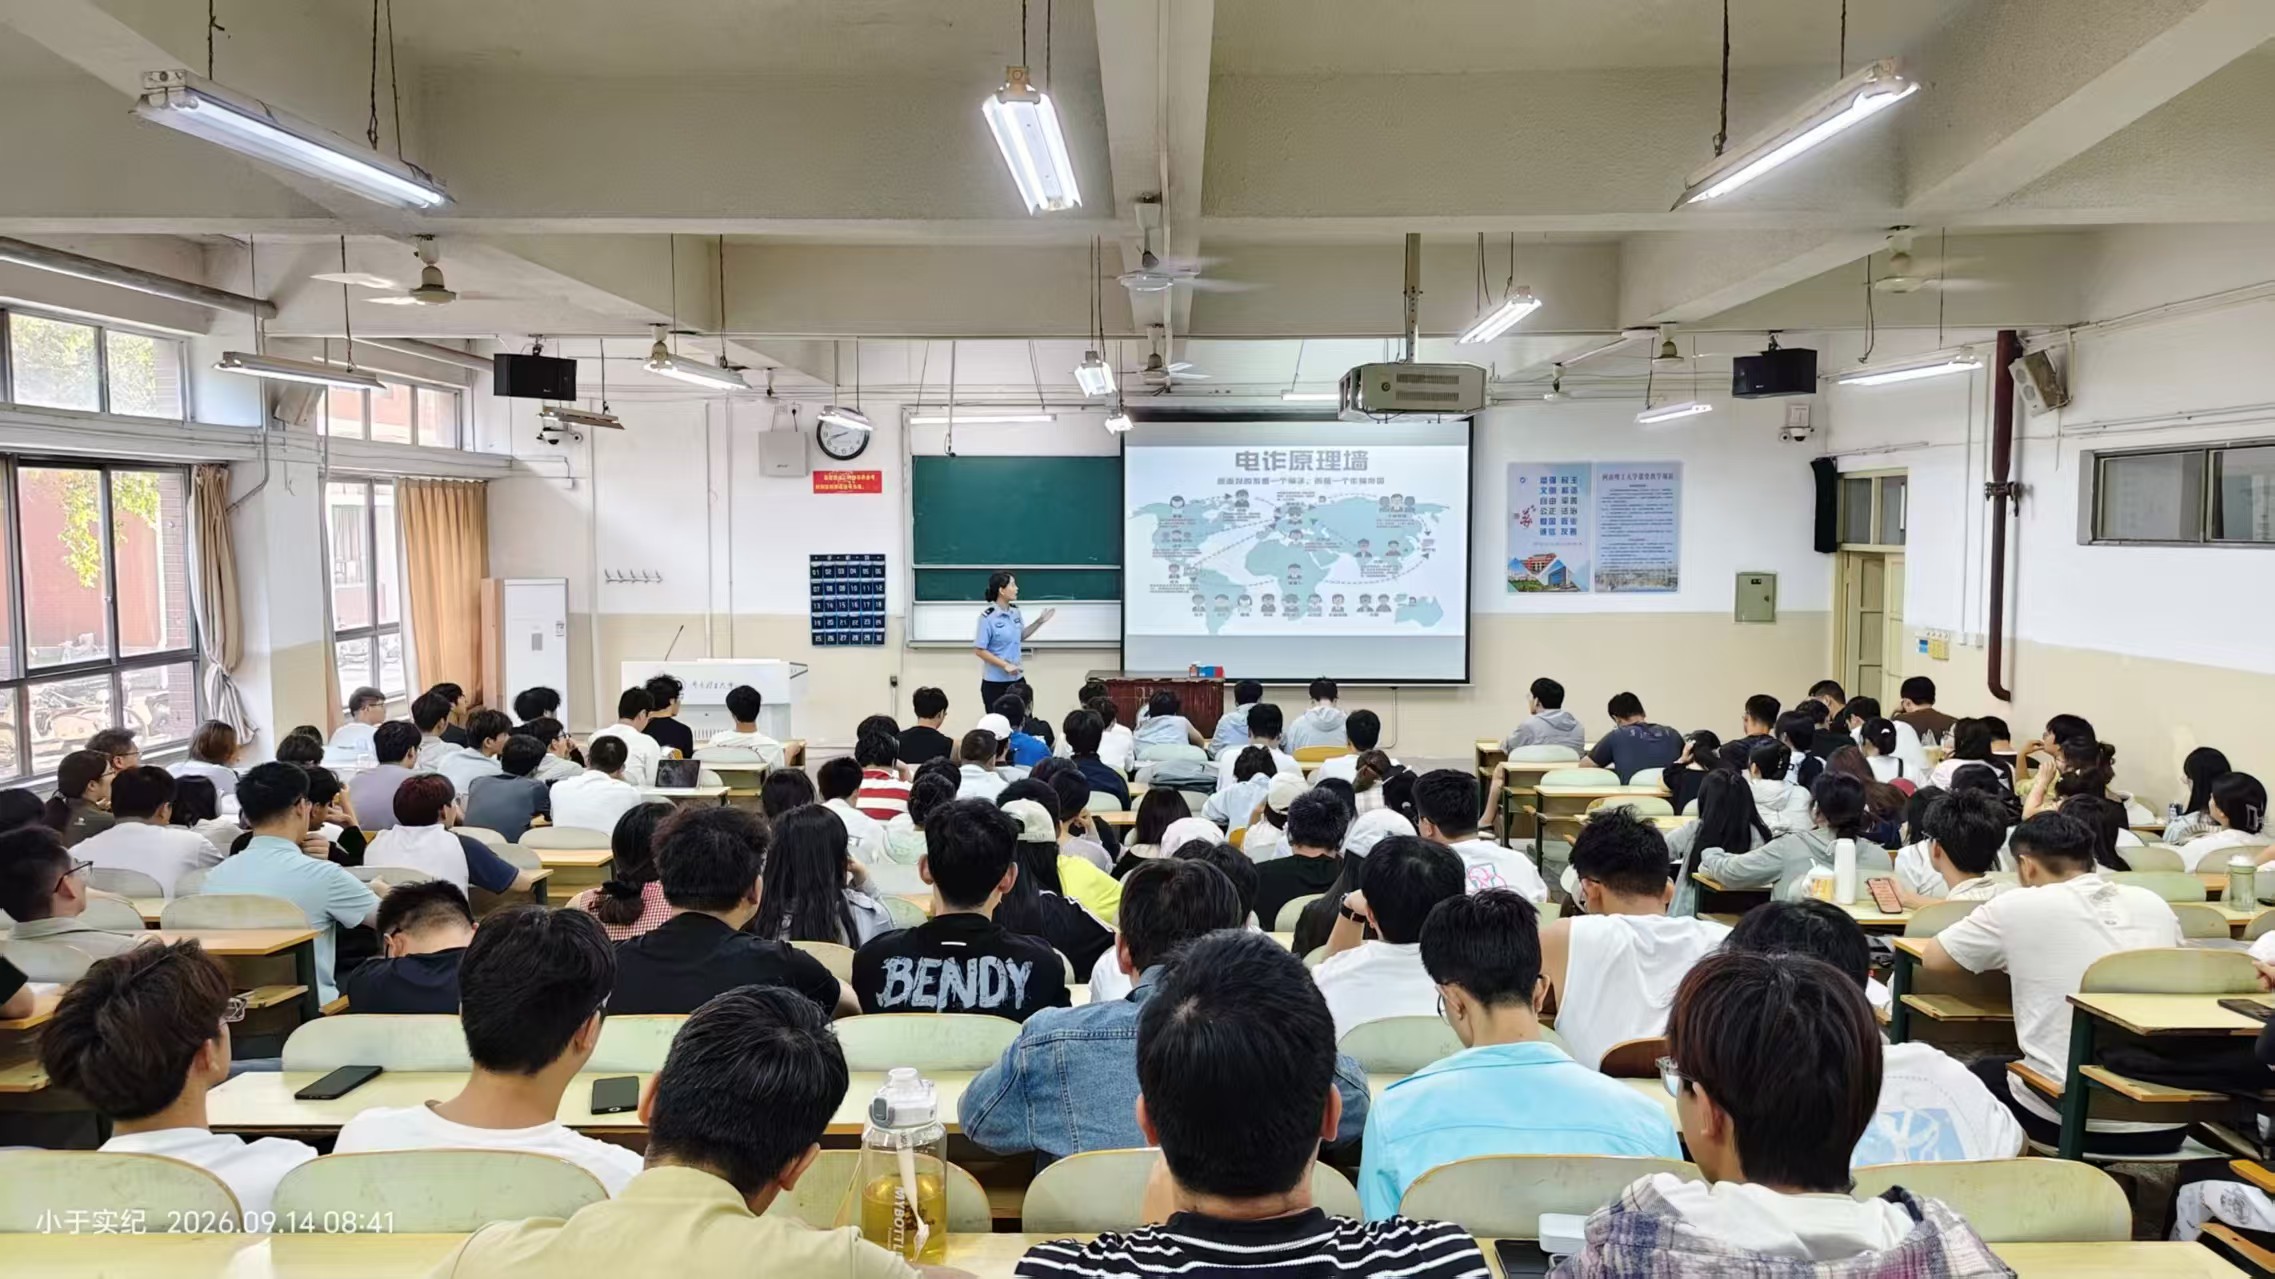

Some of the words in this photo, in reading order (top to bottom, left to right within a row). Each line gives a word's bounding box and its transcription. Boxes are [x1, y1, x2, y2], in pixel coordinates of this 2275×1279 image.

[1235, 450, 1369, 471] 电诈原理墙
[875, 956, 1033, 1012] BENDY
[894, 1186, 905, 1254] MYBOTTL
